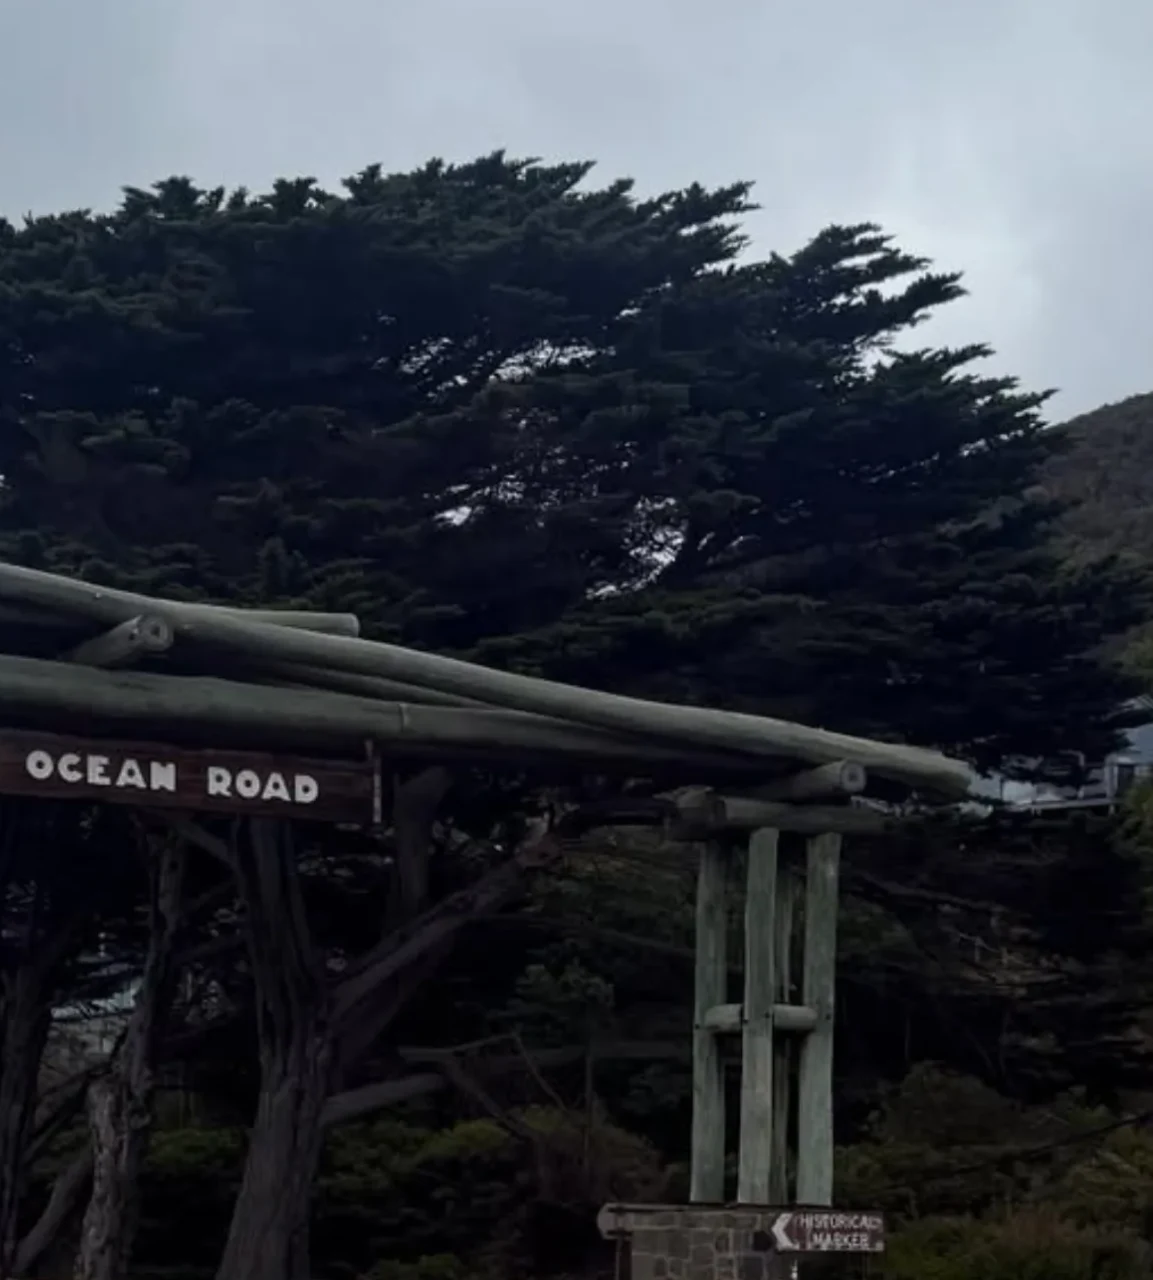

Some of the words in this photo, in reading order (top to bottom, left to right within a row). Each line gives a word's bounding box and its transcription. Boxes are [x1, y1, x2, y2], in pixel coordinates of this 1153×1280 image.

[26, 751, 177, 791] OCEAN
[208, 766, 320, 804] ROAD
[811, 1233, 870, 1247] MARKER
